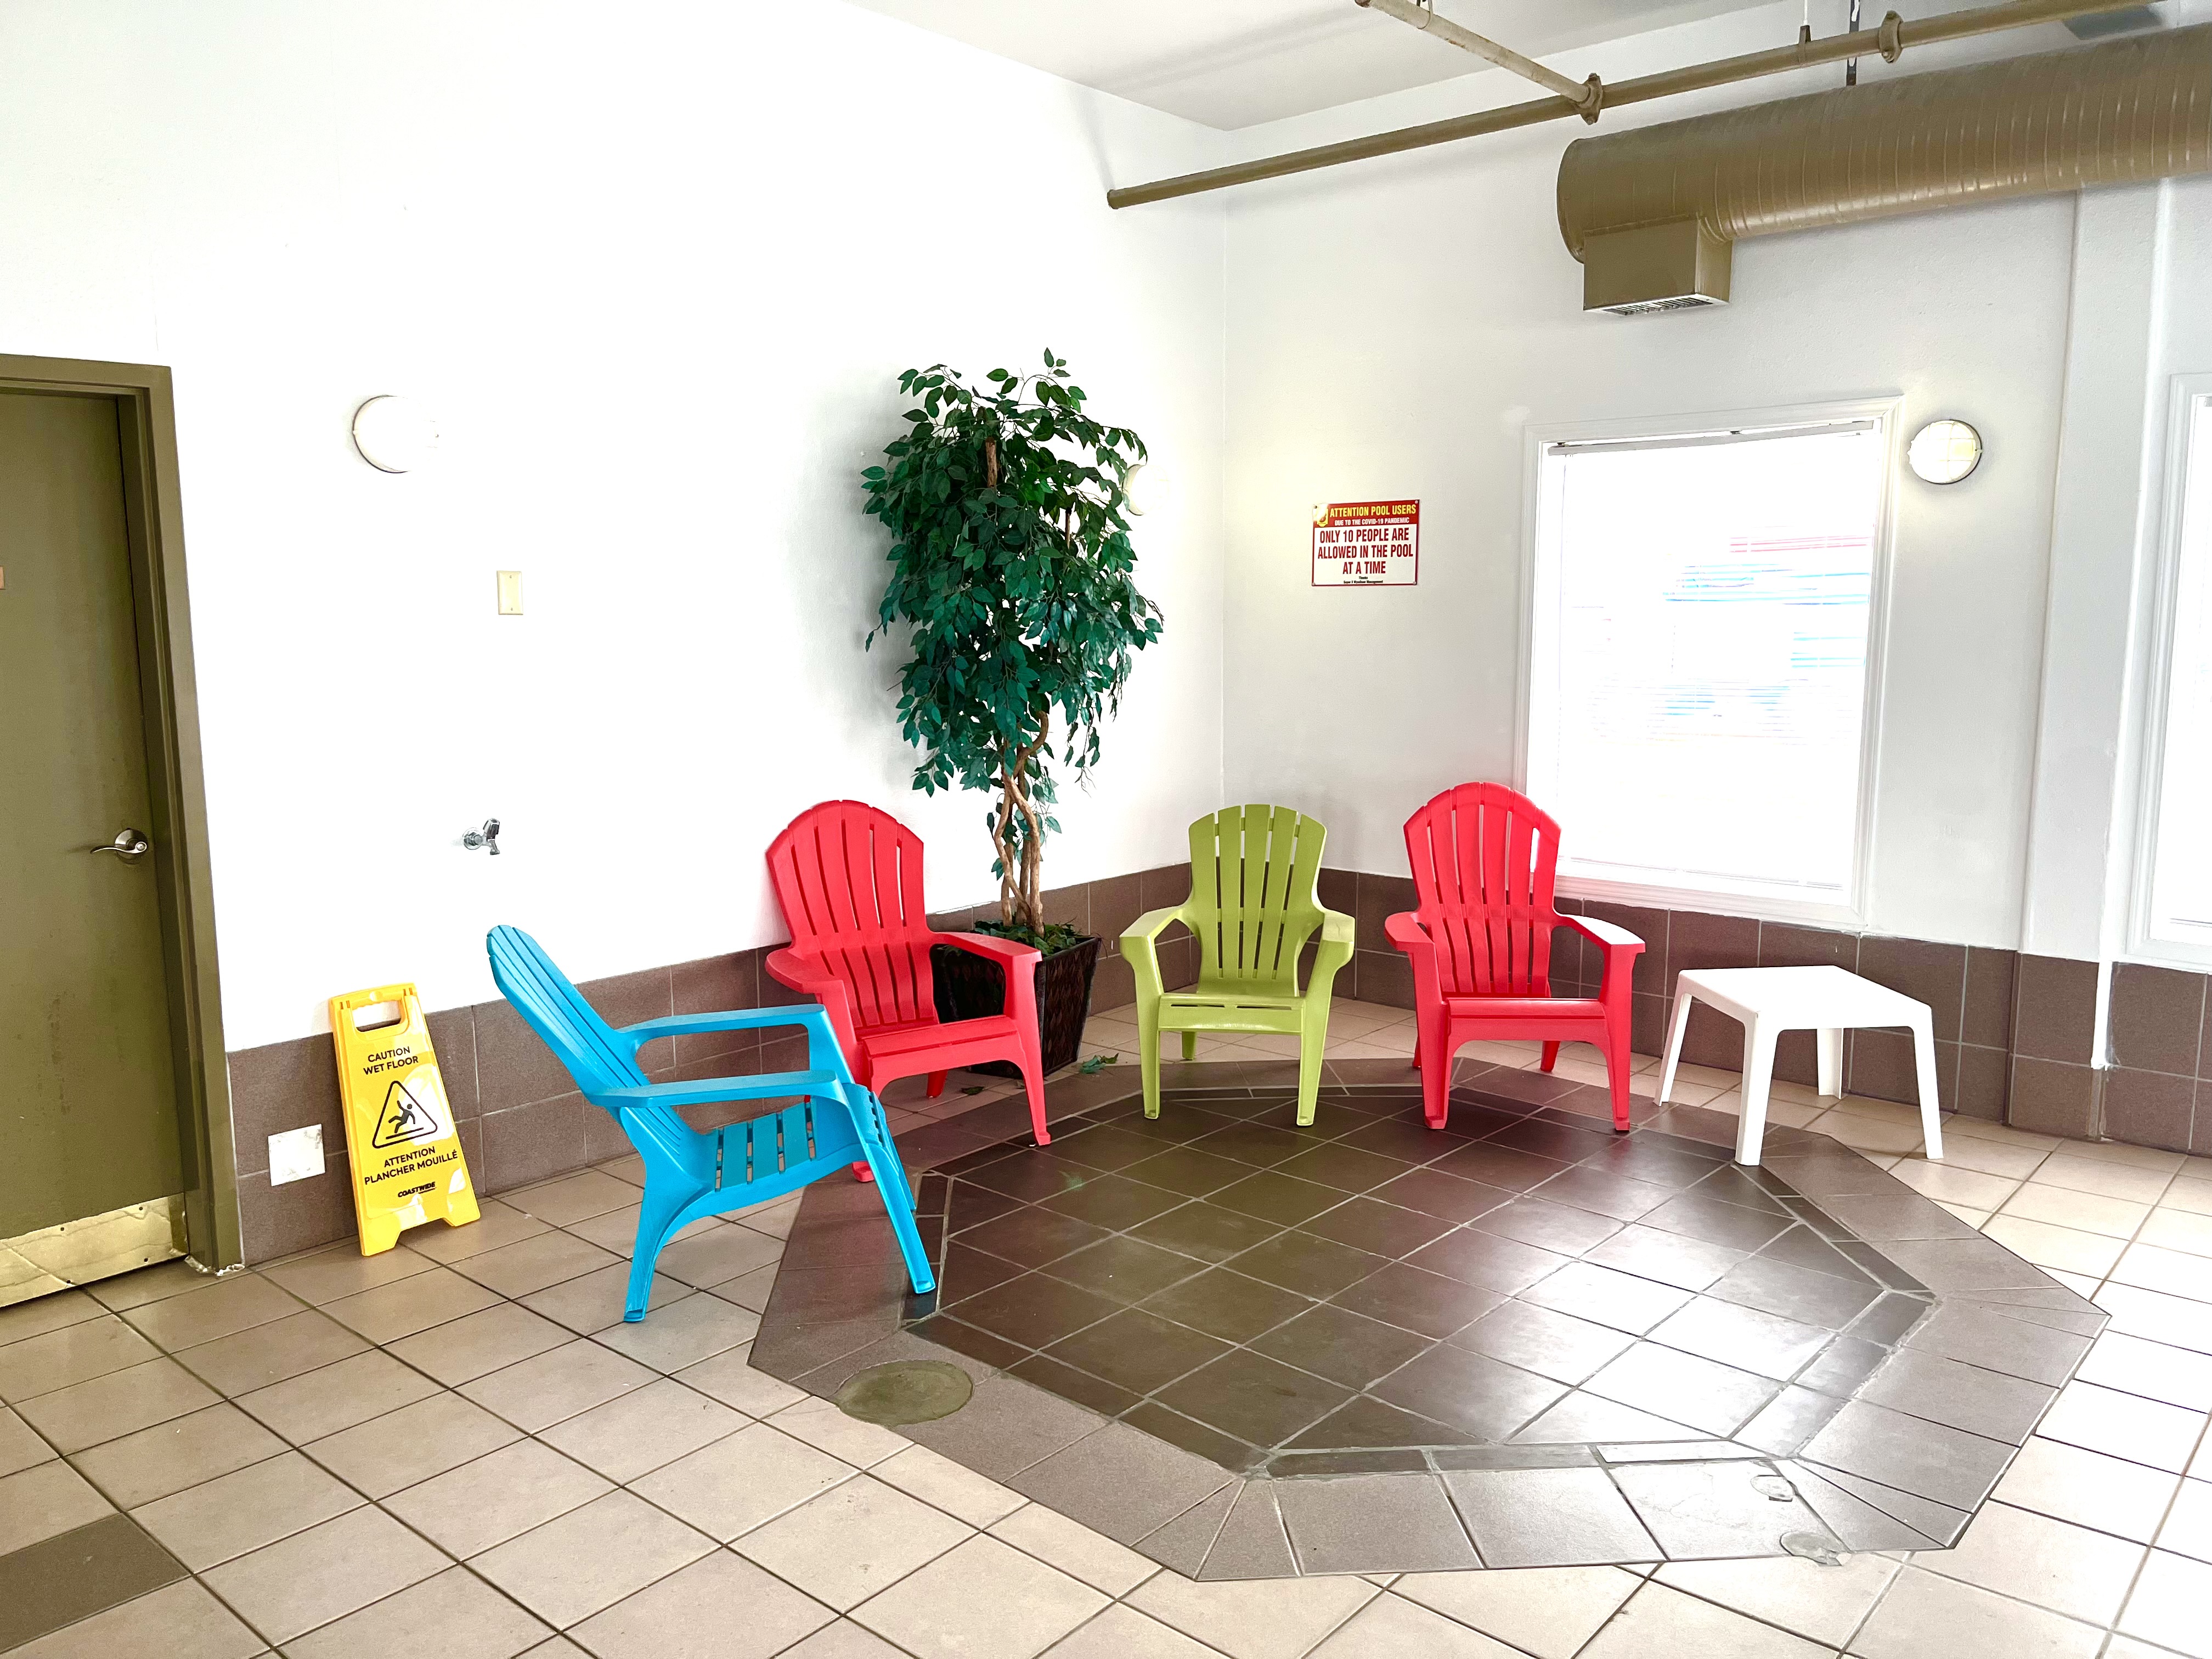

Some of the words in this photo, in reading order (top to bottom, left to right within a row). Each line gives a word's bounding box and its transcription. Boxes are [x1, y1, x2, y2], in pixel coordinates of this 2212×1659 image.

[1330, 506, 1369, 517] ATTENTION
[1371, 505, 1390, 516] POOL
[1392, 504, 1417, 515] USERS
[1320, 530, 1340, 543] ONLY
[1343, 529, 1353, 543] 10
[1356, 528, 1389, 542] PEOPLE
[1391, 527, 1409, 541] ARE
[1318, 545, 1357, 559] ALLOWED
[1360, 545, 1368, 558] IN
[1372, 545, 1387, 557] THE
[1391, 544, 1413, 557] POOL
[1342, 561, 1353, 574] AT
[1356, 561, 1362, 574] A
[1364, 561, 1386, 574] TIME
[368, 1046, 410, 1062] CAUTION
[363, 1063, 385, 1075] WET
[387, 1056, 419, 1070] FLOOR
[384, 1146, 436, 1167] ATTENTION
[364, 1164, 415, 1185] PLANCHER
[417, 1149, 458, 1170] MOUILLÉ
[398, 1181, 436, 1198] COASTWIDE
